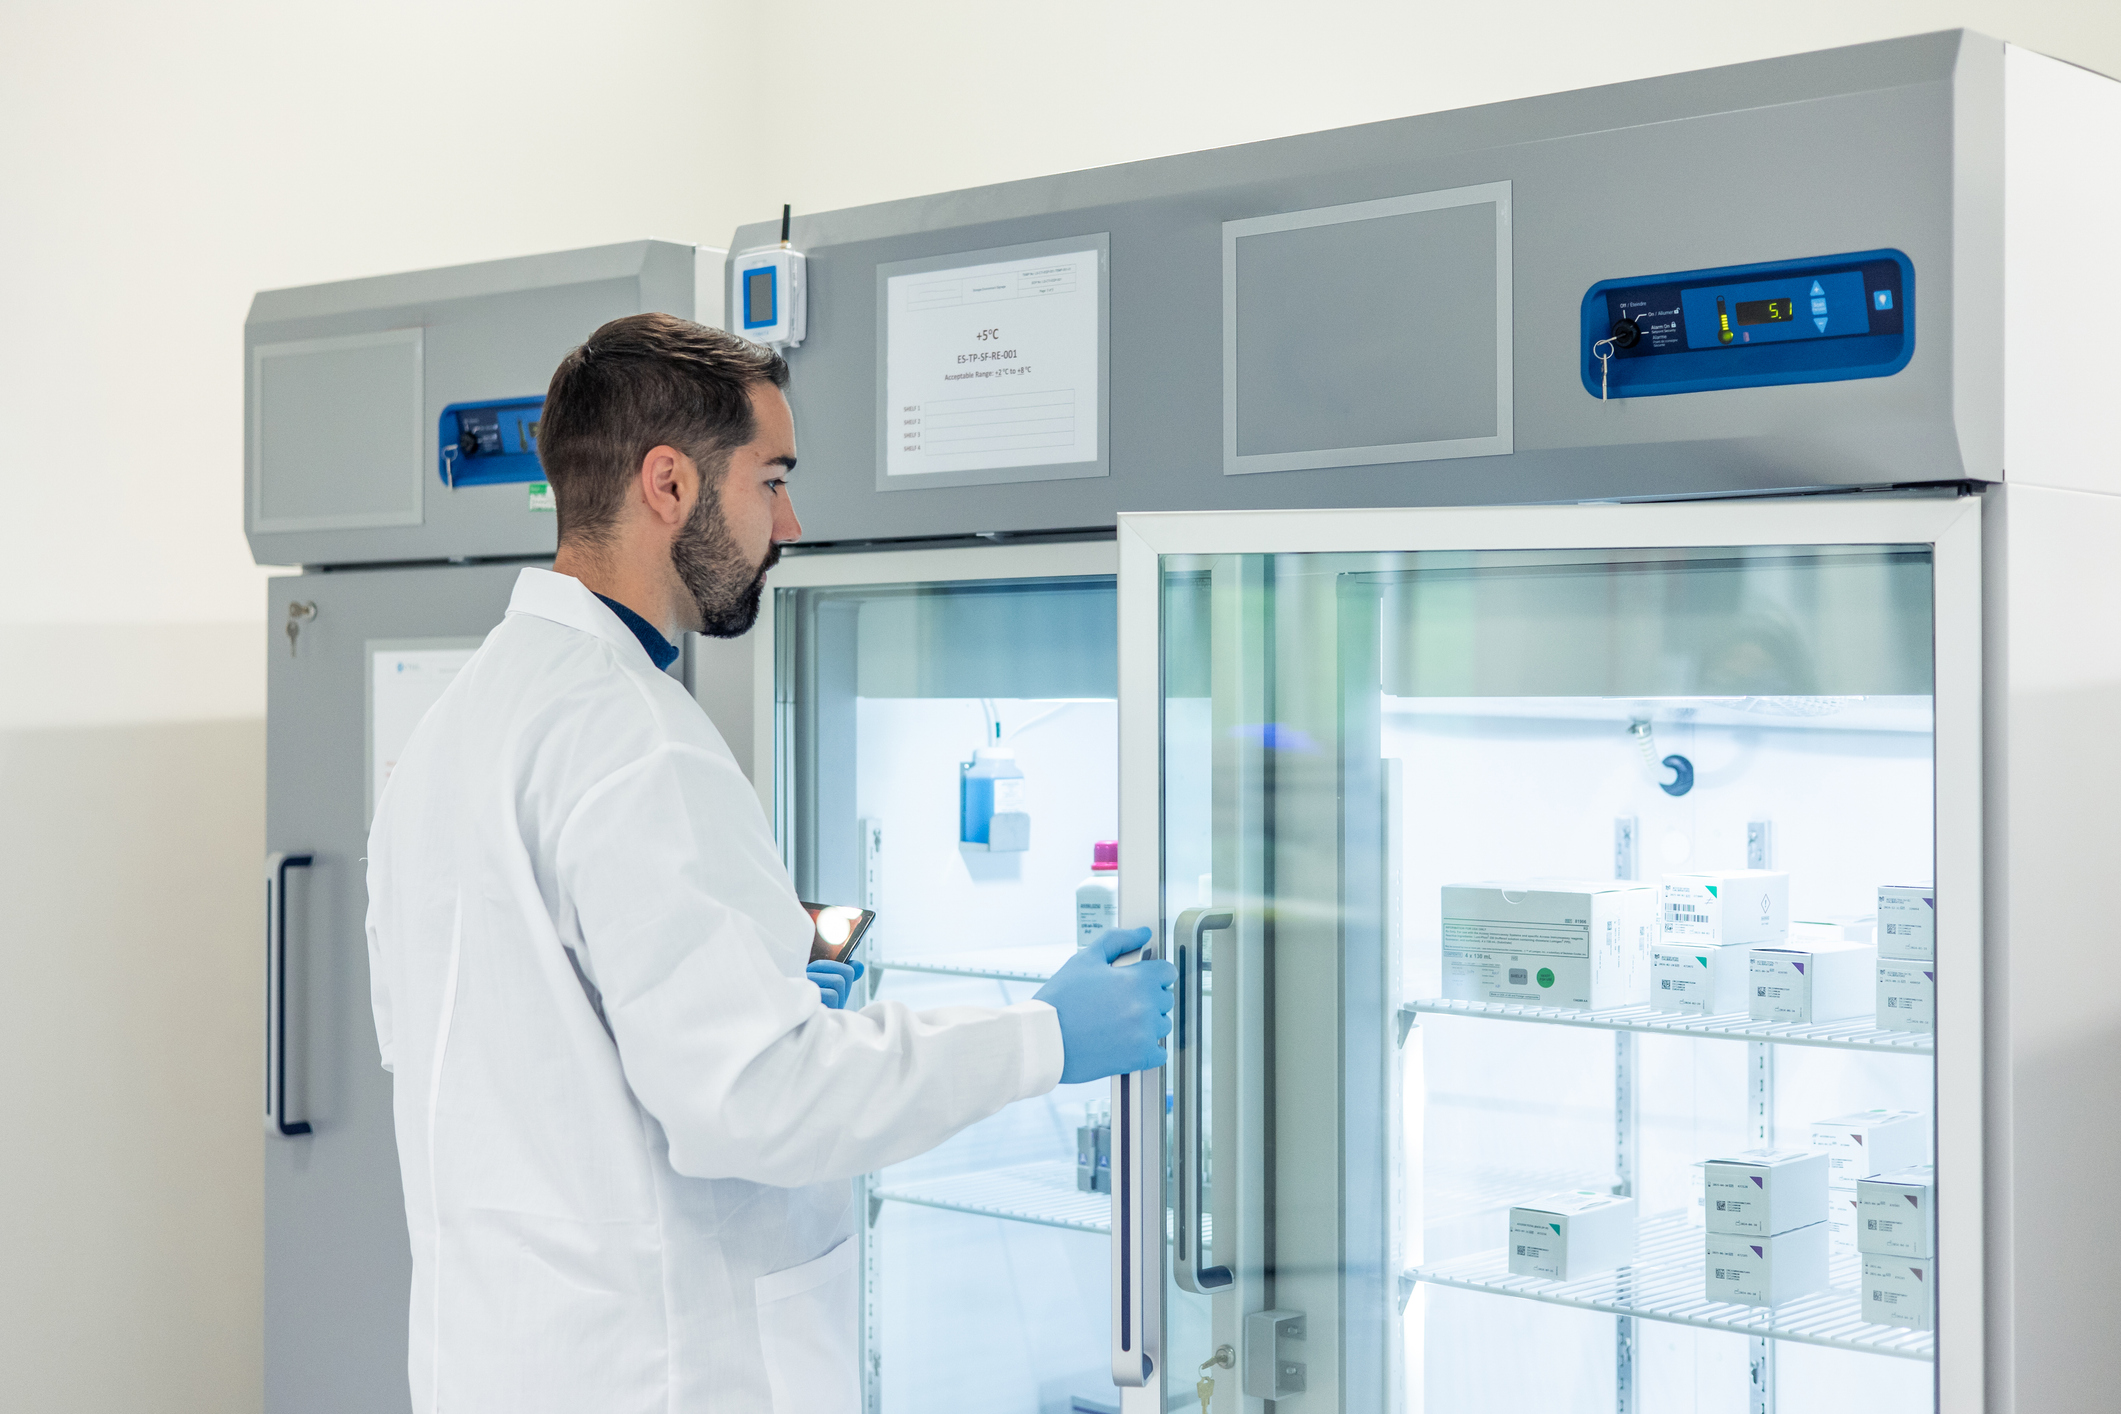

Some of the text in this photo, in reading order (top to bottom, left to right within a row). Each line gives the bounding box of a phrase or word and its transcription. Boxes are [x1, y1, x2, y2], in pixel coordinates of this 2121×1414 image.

[1770, 302, 1792, 320] 5.1
[977, 328, 1000, 342] +5°C
[958, 350, 1018, 364] ES-TP-SF-RE-001
[944, 372, 974, 382] Acceptable
[975, 370, 995, 379] Range:
